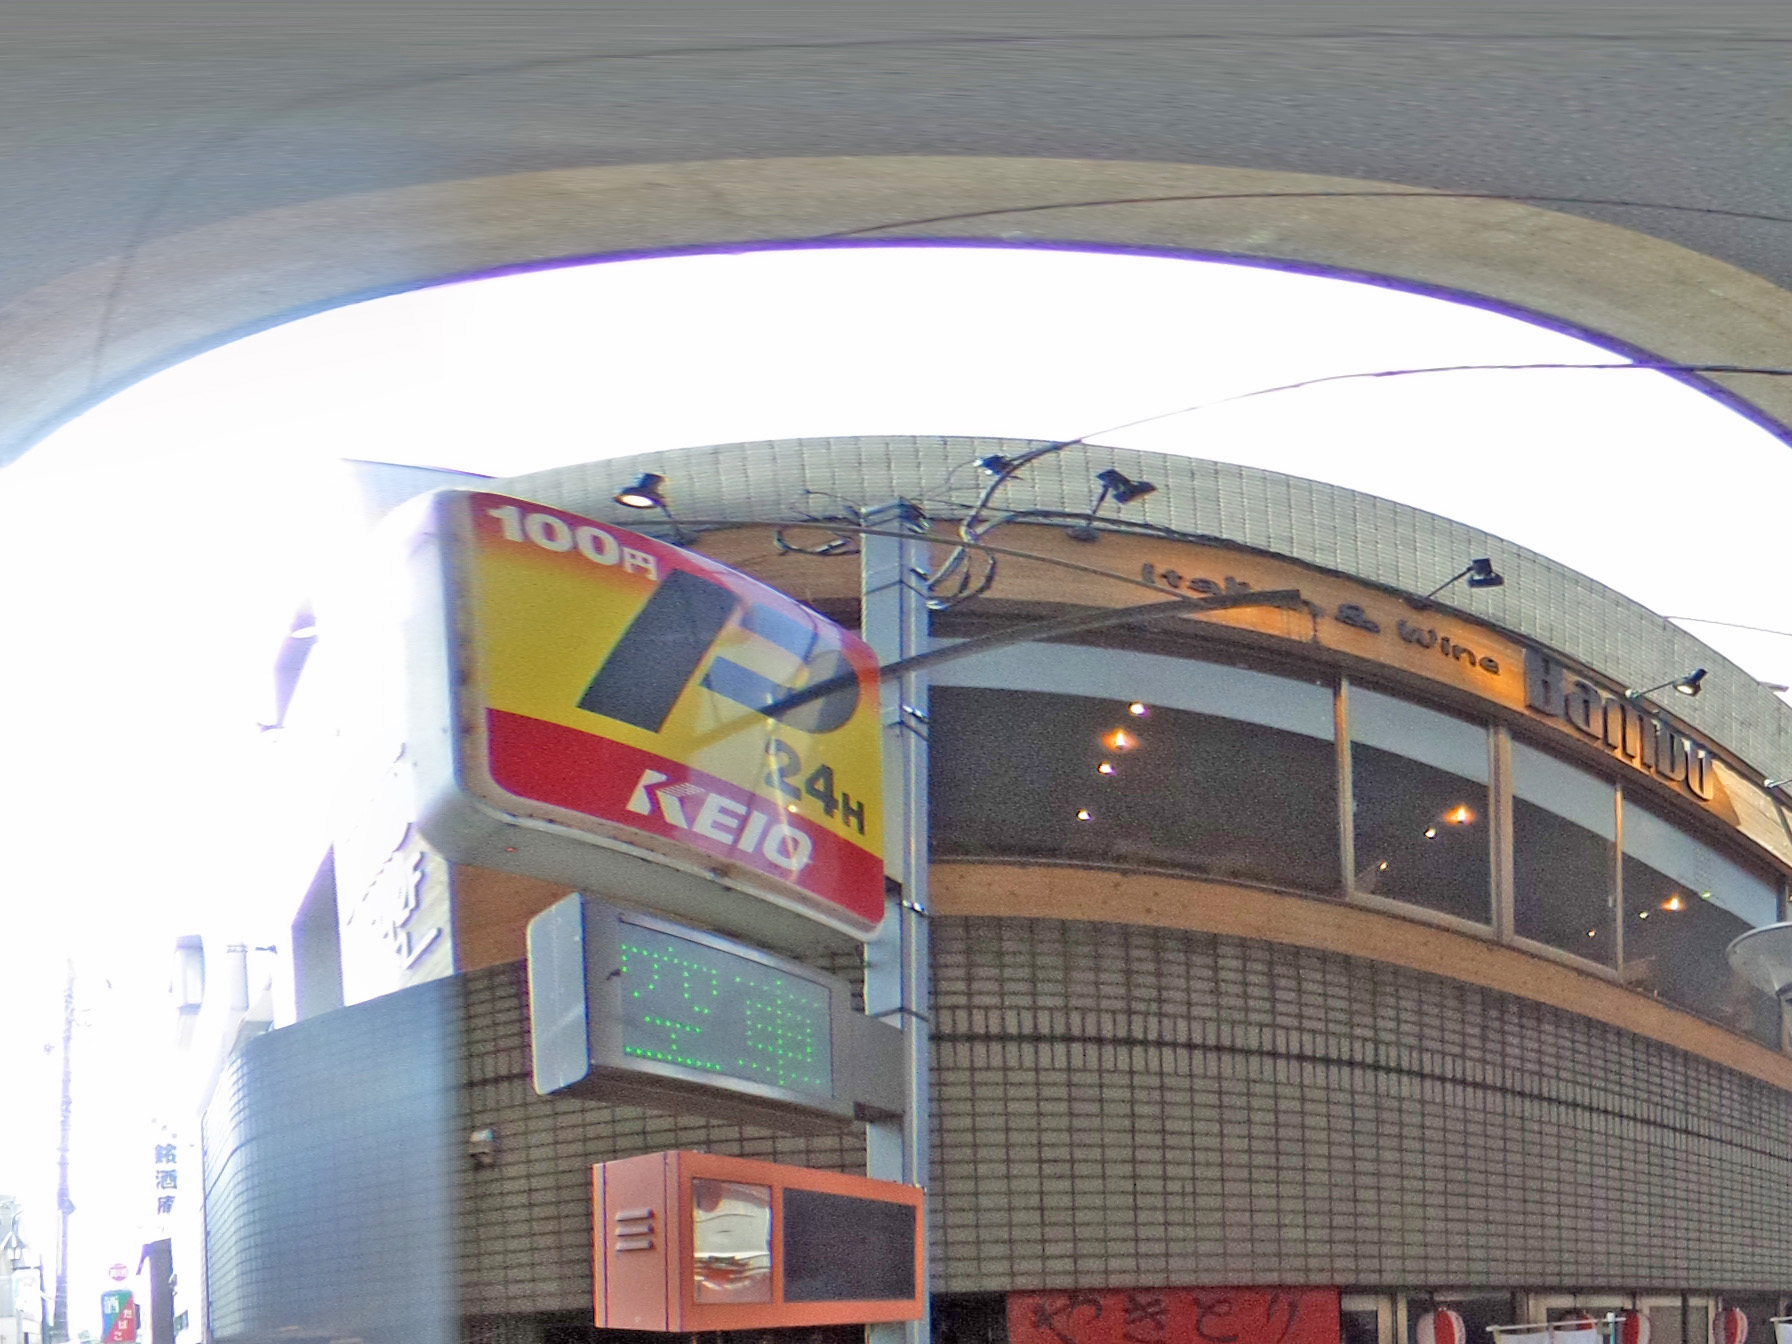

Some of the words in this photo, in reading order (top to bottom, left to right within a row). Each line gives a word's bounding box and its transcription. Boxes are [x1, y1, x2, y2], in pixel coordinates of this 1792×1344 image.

[488, 505, 658, 580] 100円
[576, 568, 861, 735] P
[1335, 604, 1380, 633] &
[1397, 618, 1501, 677] Wine
[625, 768, 813, 872] KEIO
[764, 738, 866, 837] 24H
[619, 944, 822, 1087] 空車
